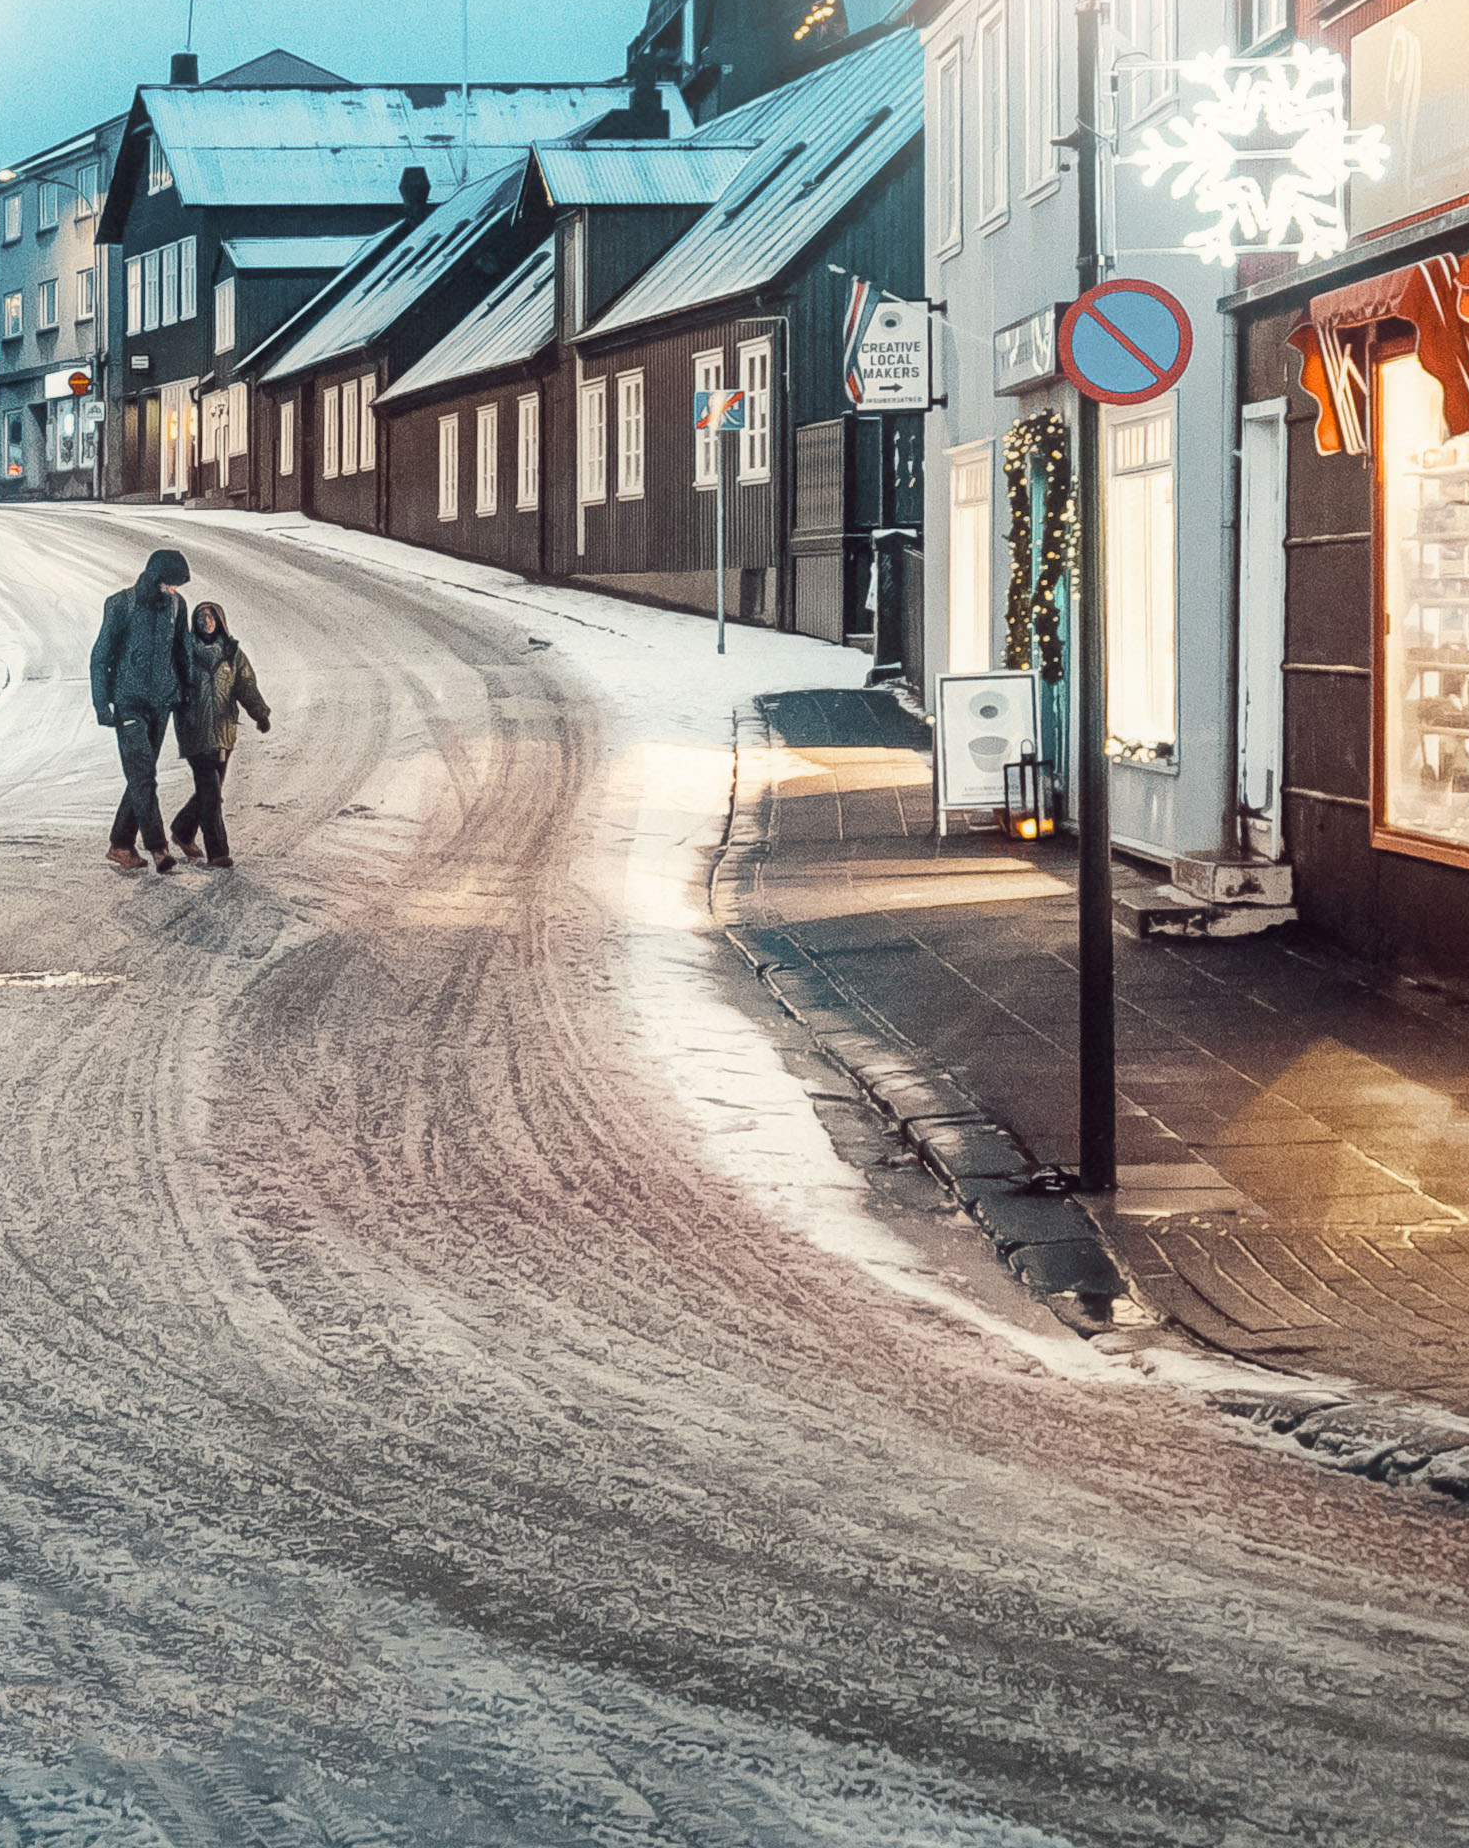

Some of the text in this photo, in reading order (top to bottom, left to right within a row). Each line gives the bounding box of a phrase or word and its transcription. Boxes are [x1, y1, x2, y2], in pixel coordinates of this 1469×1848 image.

[861, 341, 922, 353] CREATIVE
[870, 353, 913, 366] LOCAL
[863, 366, 920, 379] MAKERS
